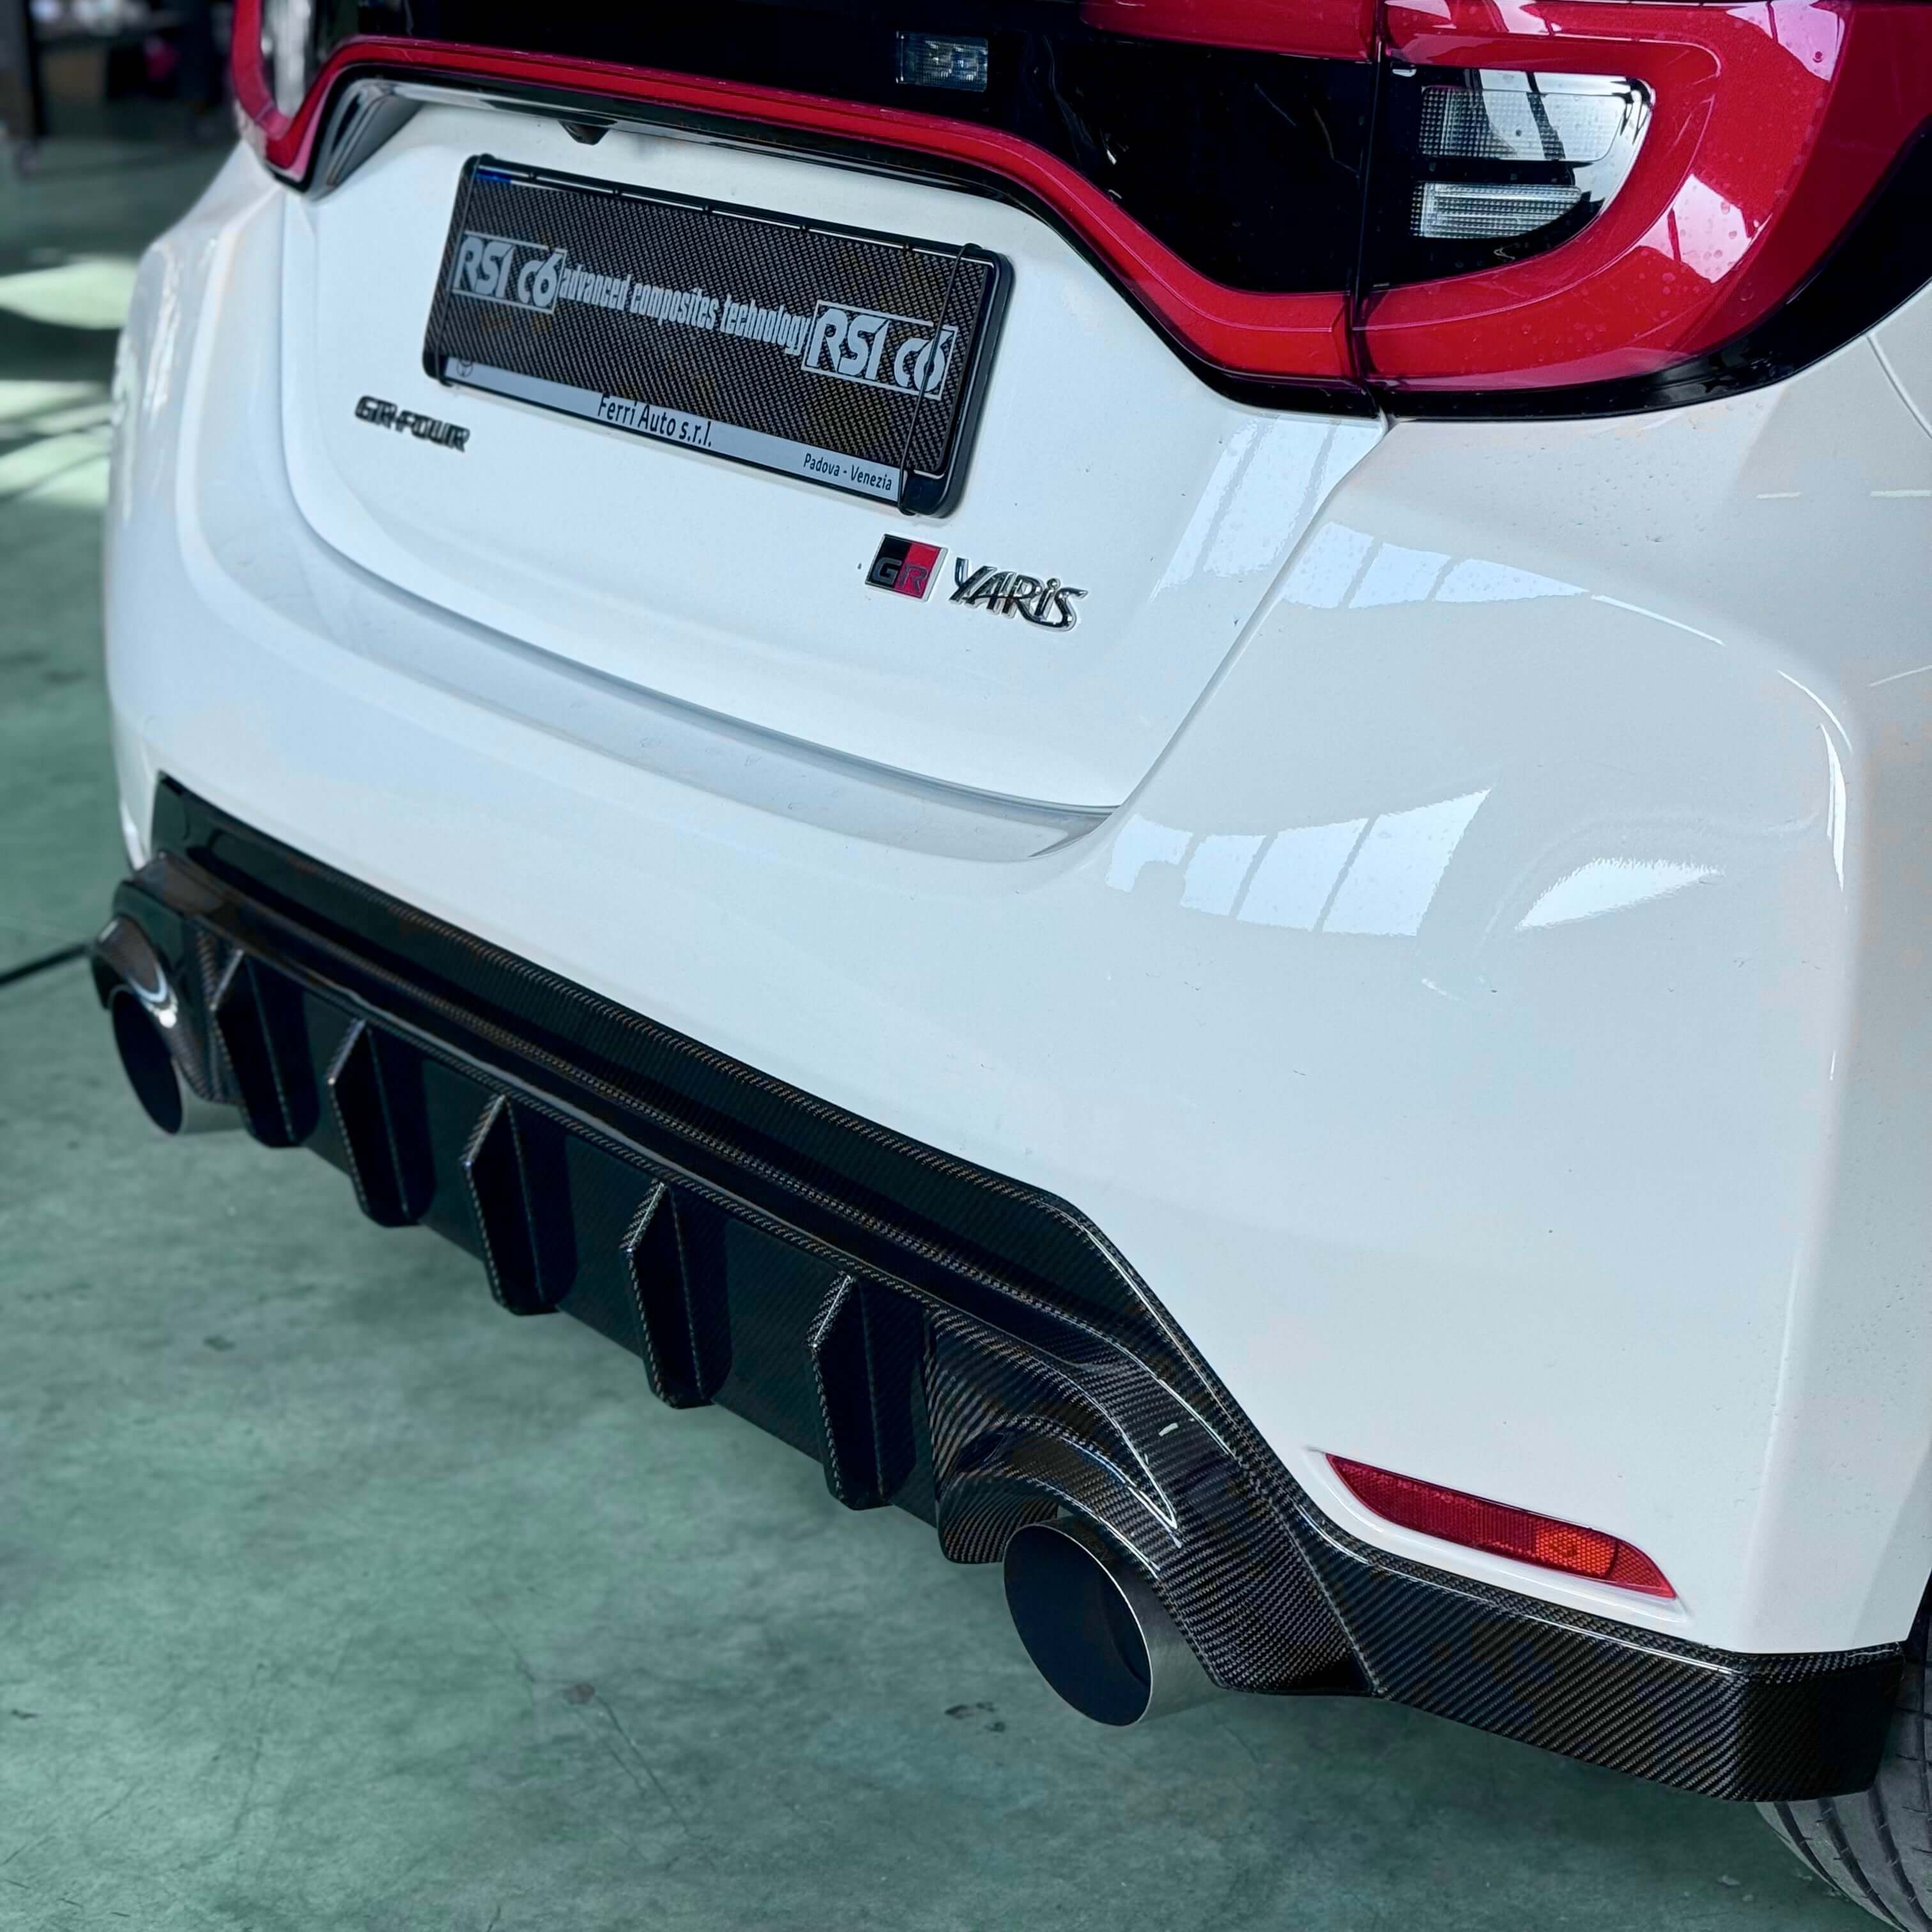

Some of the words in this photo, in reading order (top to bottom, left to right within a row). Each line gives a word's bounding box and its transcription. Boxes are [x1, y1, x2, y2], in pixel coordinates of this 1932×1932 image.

[452, 236, 516, 298] RSI
[559, 264, 632, 311] advanced
[630, 282, 720, 326] composites
[719, 293, 811, 356] technology
[806, 307, 890, 380] RSI
[355, 395, 471, 453] GR-FOUR
[597, 394, 638, 425] Ferri
[638, 403, 676, 436] Auto
[678, 420, 712, 447] s.r.l.
[803, 452, 840, 477] Padova
[850, 464, 893, 491] Venezia
[869, 556, 930, 593] GR
